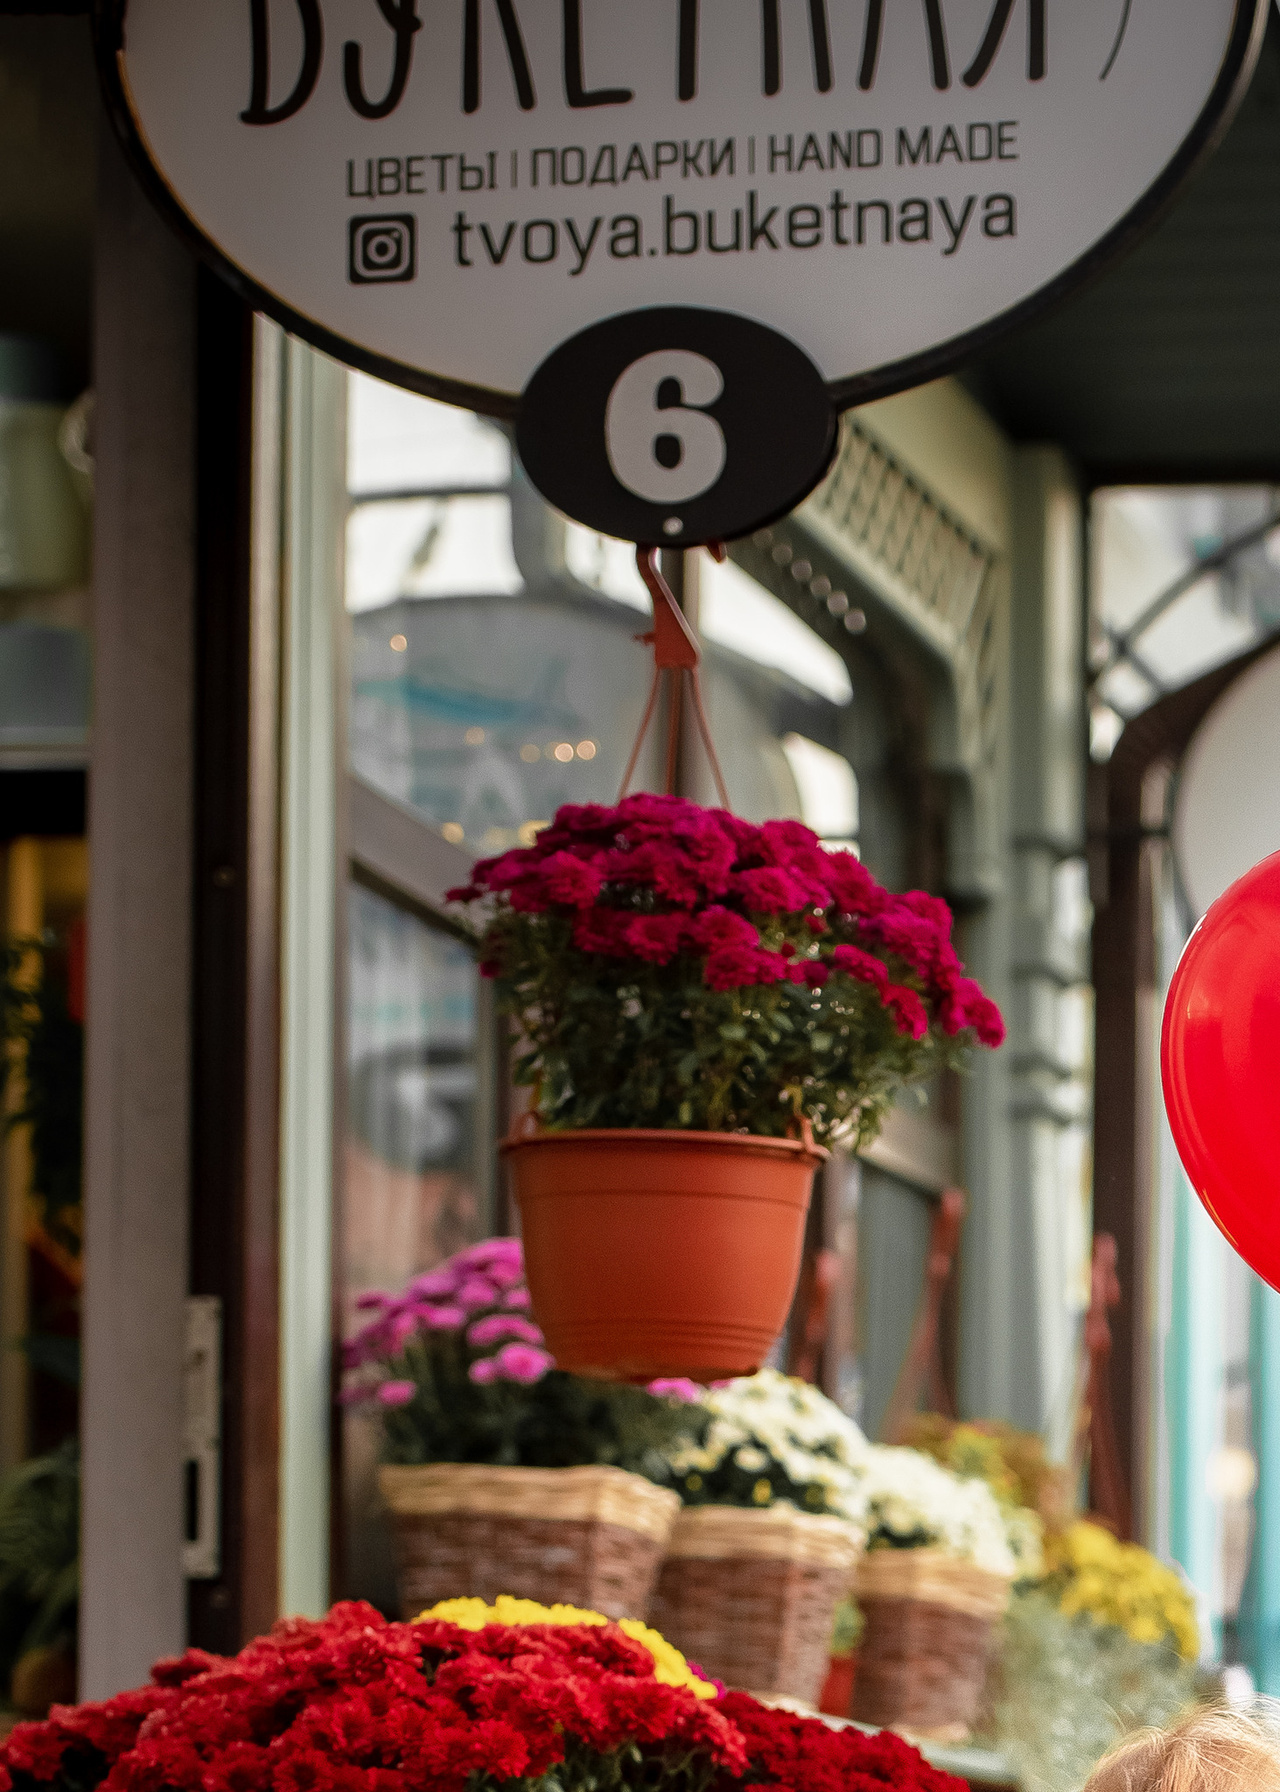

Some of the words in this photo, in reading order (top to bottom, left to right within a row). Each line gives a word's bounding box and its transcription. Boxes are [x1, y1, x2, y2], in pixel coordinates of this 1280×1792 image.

[346, 151, 497, 199] ЦВЕТЫ
[530, 137, 735, 189] ПОДАРКИ
[768, 128, 883, 173] HAND
[897, 120, 1019, 166] MADE
[453, 189, 1017, 277] tvoya.buketnaya
[604, 348, 727, 505] 6
